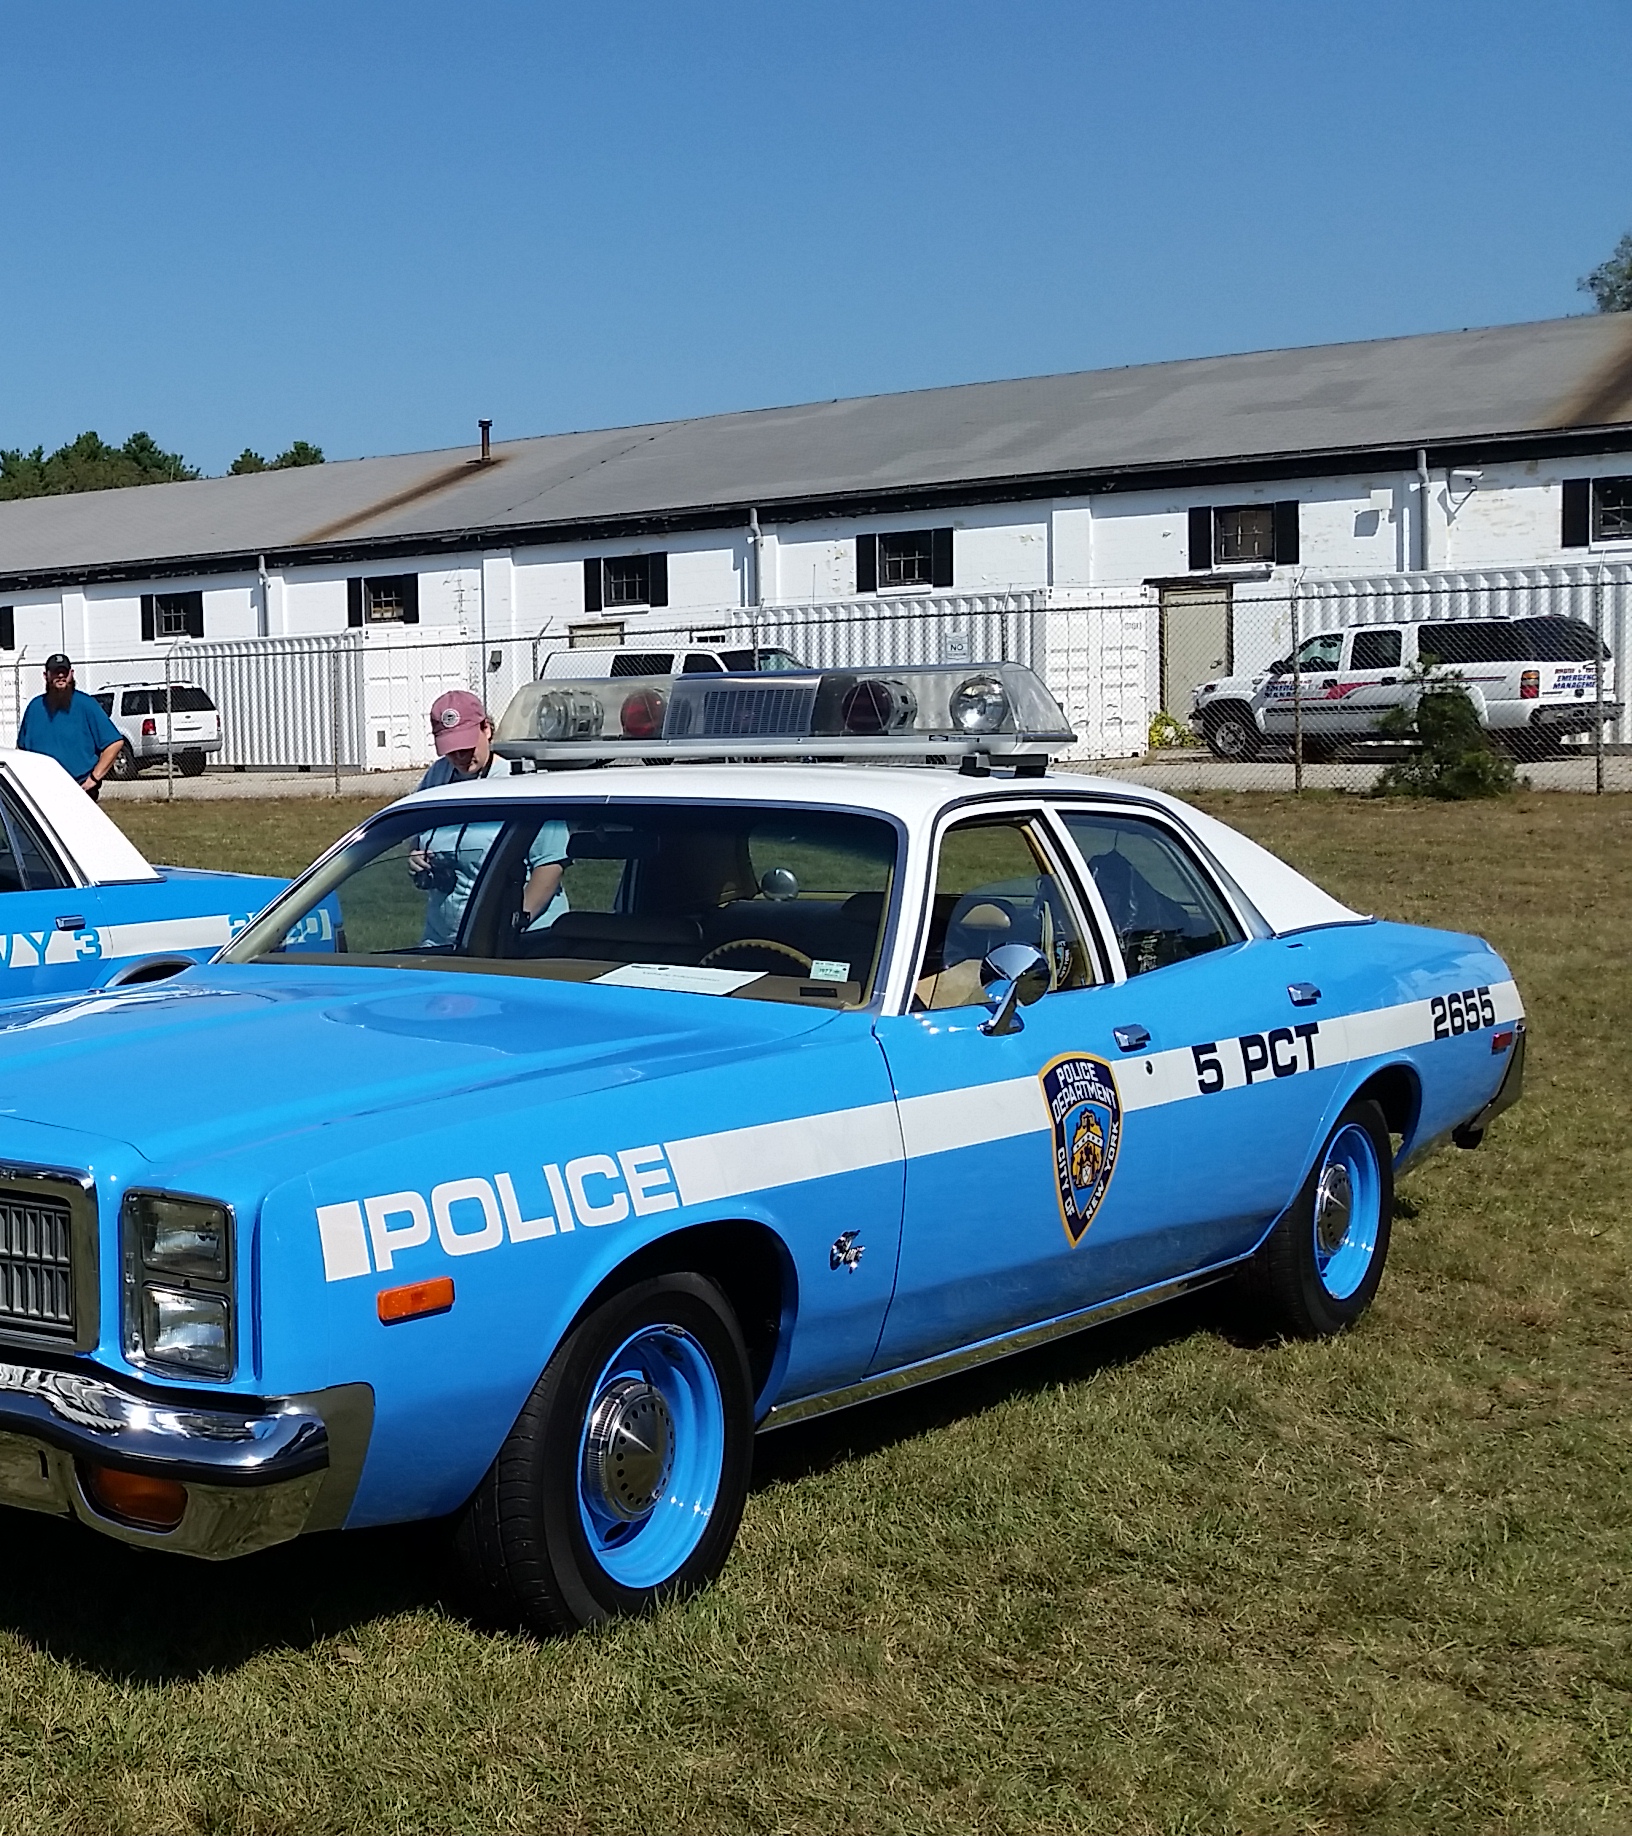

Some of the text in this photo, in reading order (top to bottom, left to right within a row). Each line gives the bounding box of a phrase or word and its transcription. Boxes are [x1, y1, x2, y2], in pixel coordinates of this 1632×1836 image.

[950, 643, 964, 651] NO
[74, 928, 103, 961] 3
[1431, 986, 1496, 1041] 2655
[1056, 1062, 1099, 1088] POLICE
[1191, 1021, 1320, 1095] 5 PCT
[1051, 1081, 1118, 1125] DEPARTMENT
[1057, 1146, 1076, 1217] CITY OF
[1085, 1120, 1119, 1220] NEW YORK
[364, 1144, 680, 1273] POLICE
